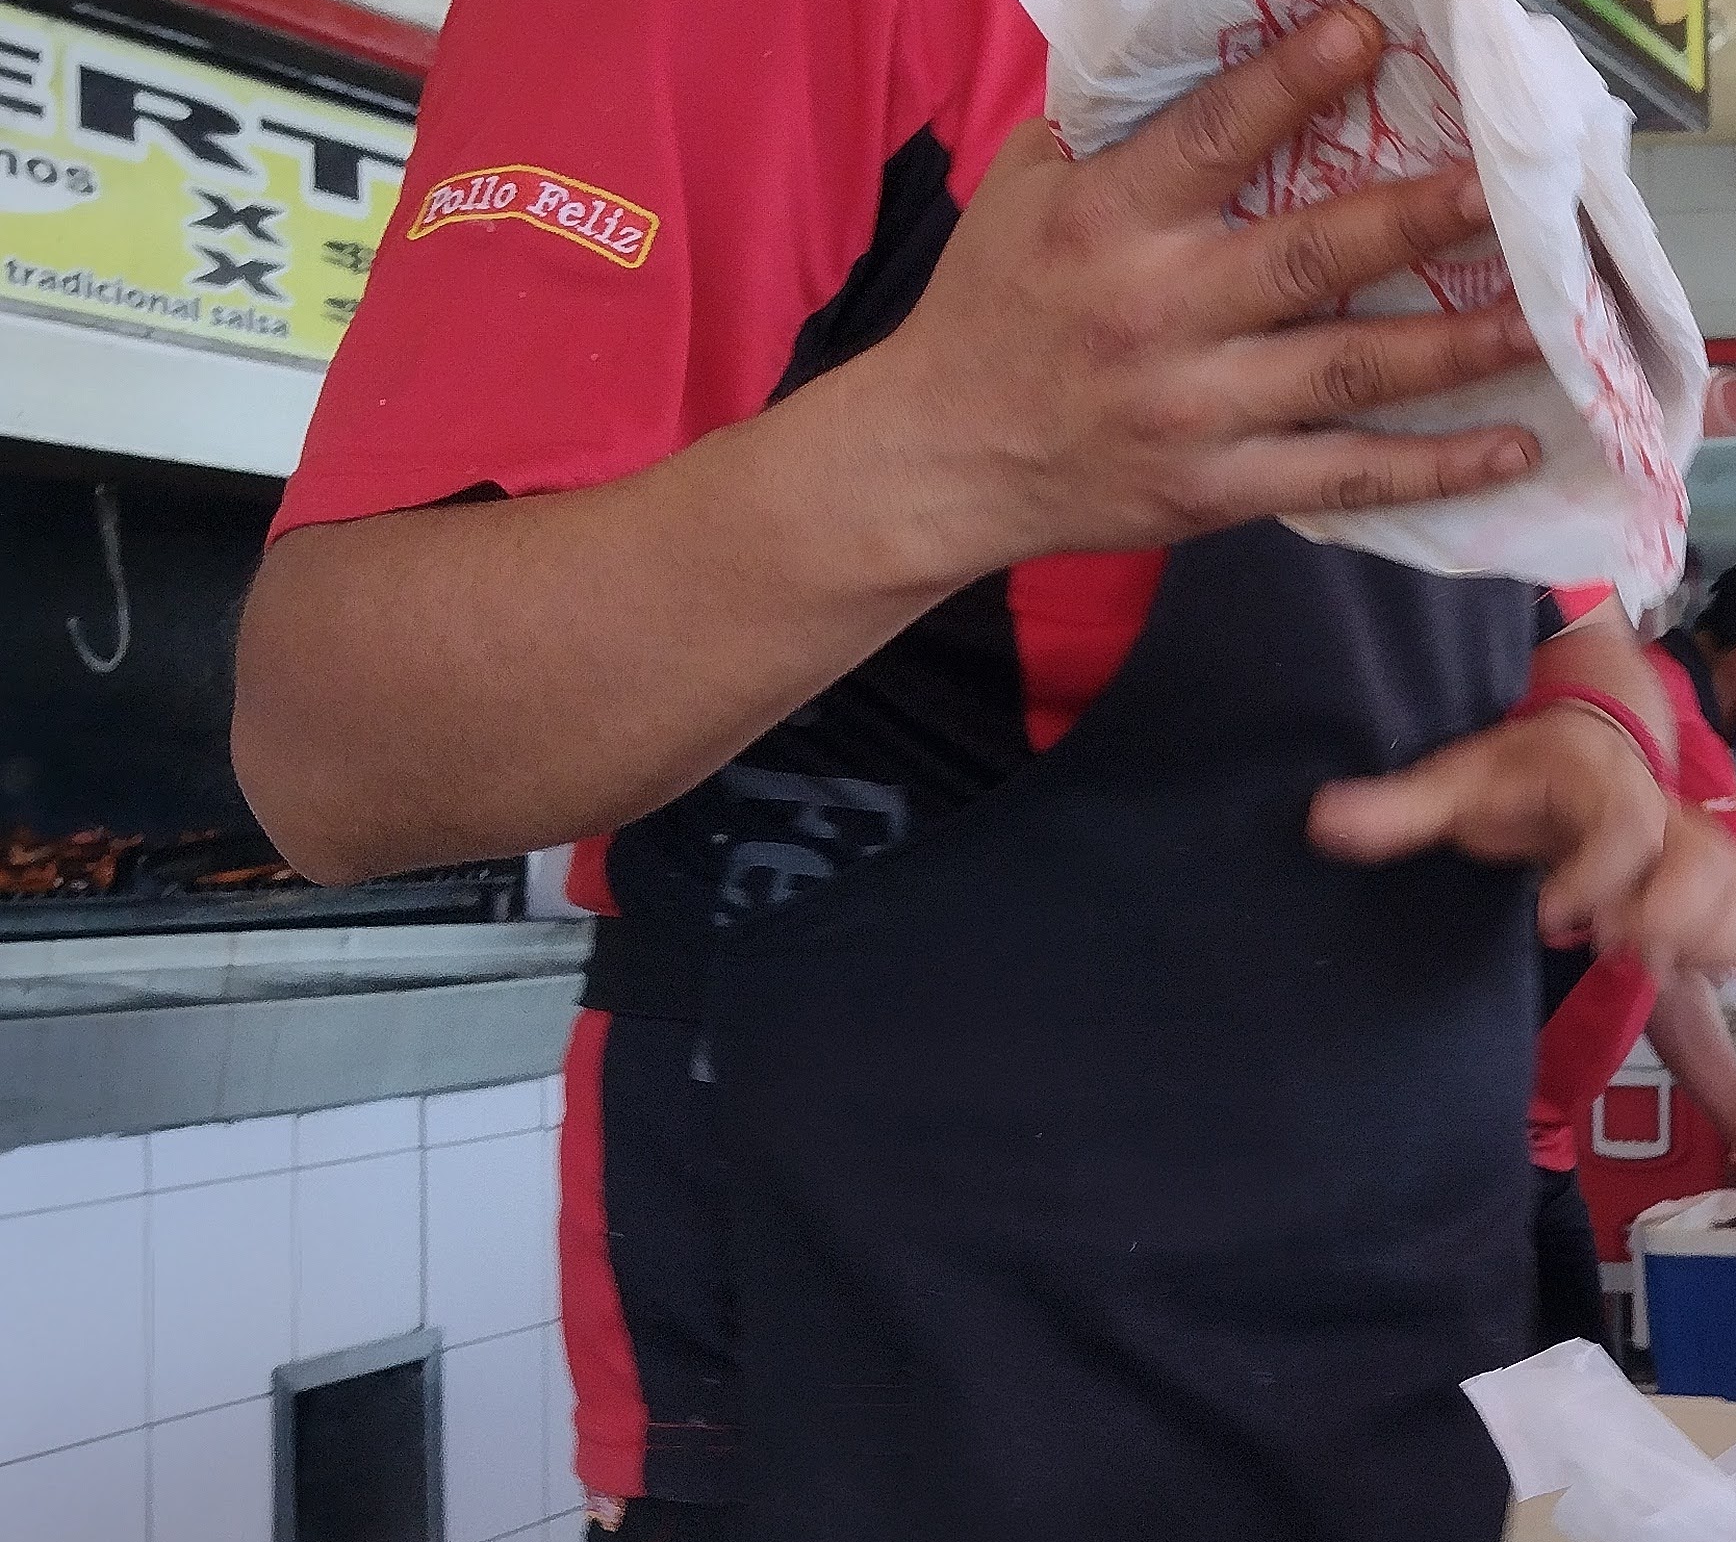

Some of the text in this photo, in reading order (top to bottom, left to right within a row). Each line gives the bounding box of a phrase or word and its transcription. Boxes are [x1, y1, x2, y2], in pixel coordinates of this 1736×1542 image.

[424, 175, 644, 253] Pollo Feliz
[6, 259, 201, 322] tradicional
